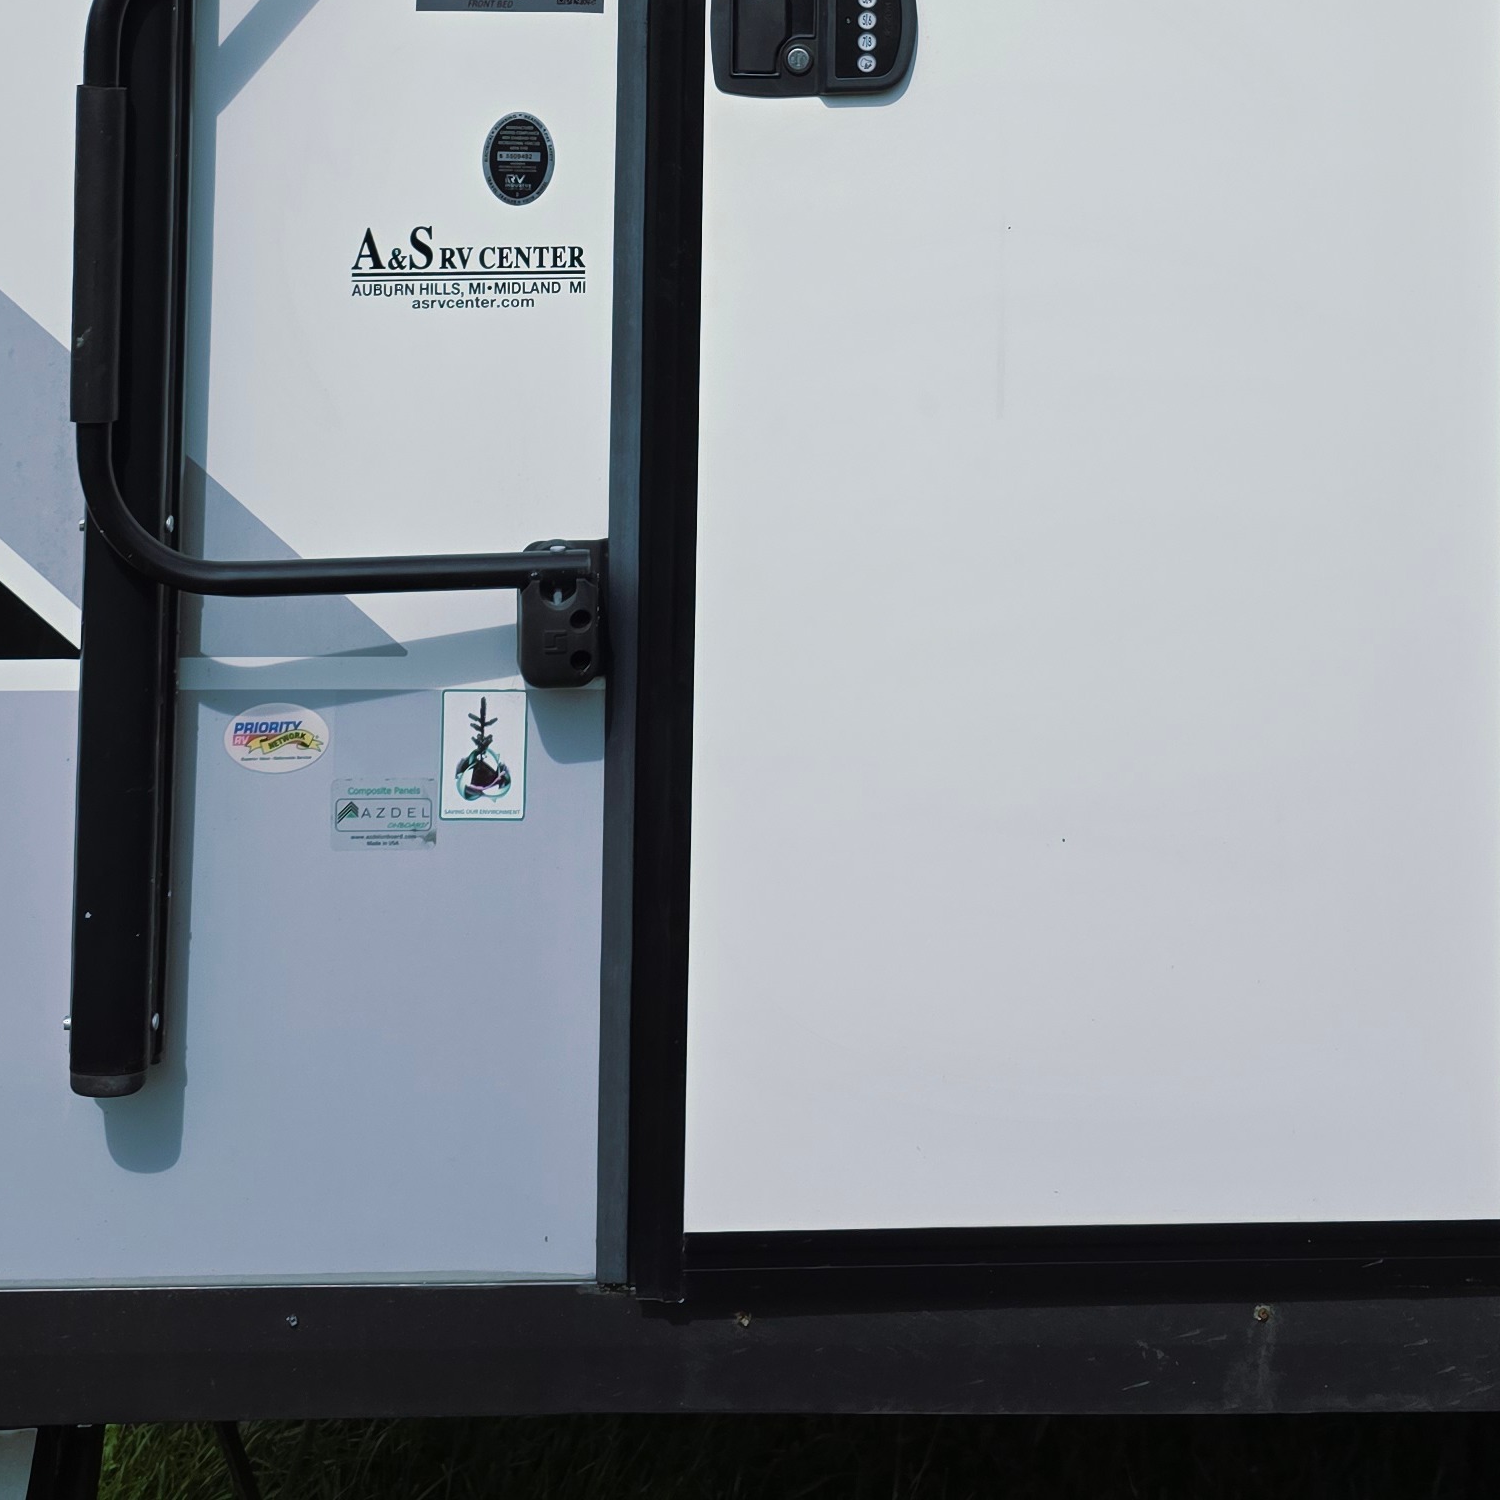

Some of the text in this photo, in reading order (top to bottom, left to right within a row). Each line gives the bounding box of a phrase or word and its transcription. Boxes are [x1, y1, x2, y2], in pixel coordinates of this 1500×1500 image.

[467, 0, 514, 9] FRONT BED
[351, 225, 586, 271] A&S RV CENTER
[351, 283, 415, 297] AUBURN
[419, 282, 465, 297] HILLS,
[569, 280, 586, 294] MI
[411, 297, 535, 309] asrvcenter.com
[233, 720, 303, 734] PRIORITY
[234, 735, 250, 745] RV
[267, 731, 307, 749] NETWORK
[347, 786, 421, 796] Composite Panels
[360, 807, 430, 819] AZDEL
